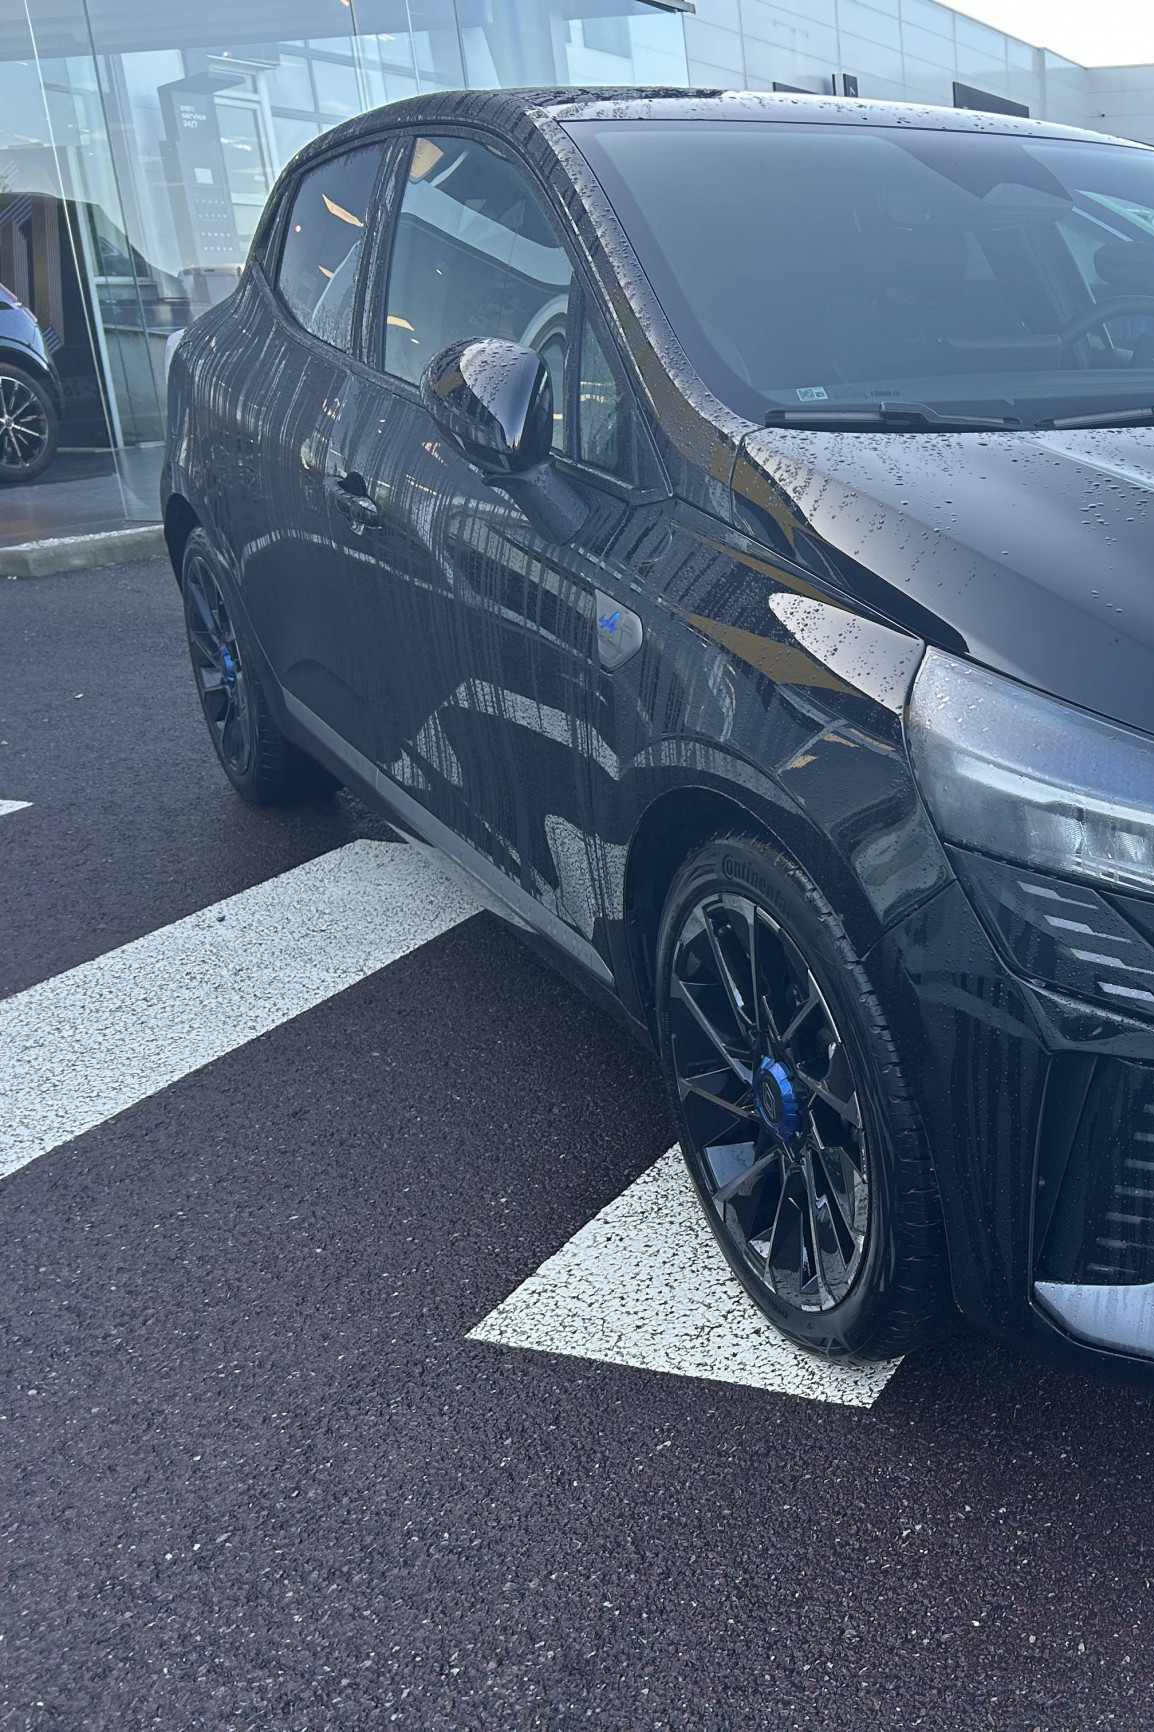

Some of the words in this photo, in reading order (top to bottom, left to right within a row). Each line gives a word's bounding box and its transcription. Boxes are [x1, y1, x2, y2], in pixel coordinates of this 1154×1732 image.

[181, 112, 207, 121] service
[182, 120, 198, 129] 24/7
[721, 853, 790, 917] Continenta
